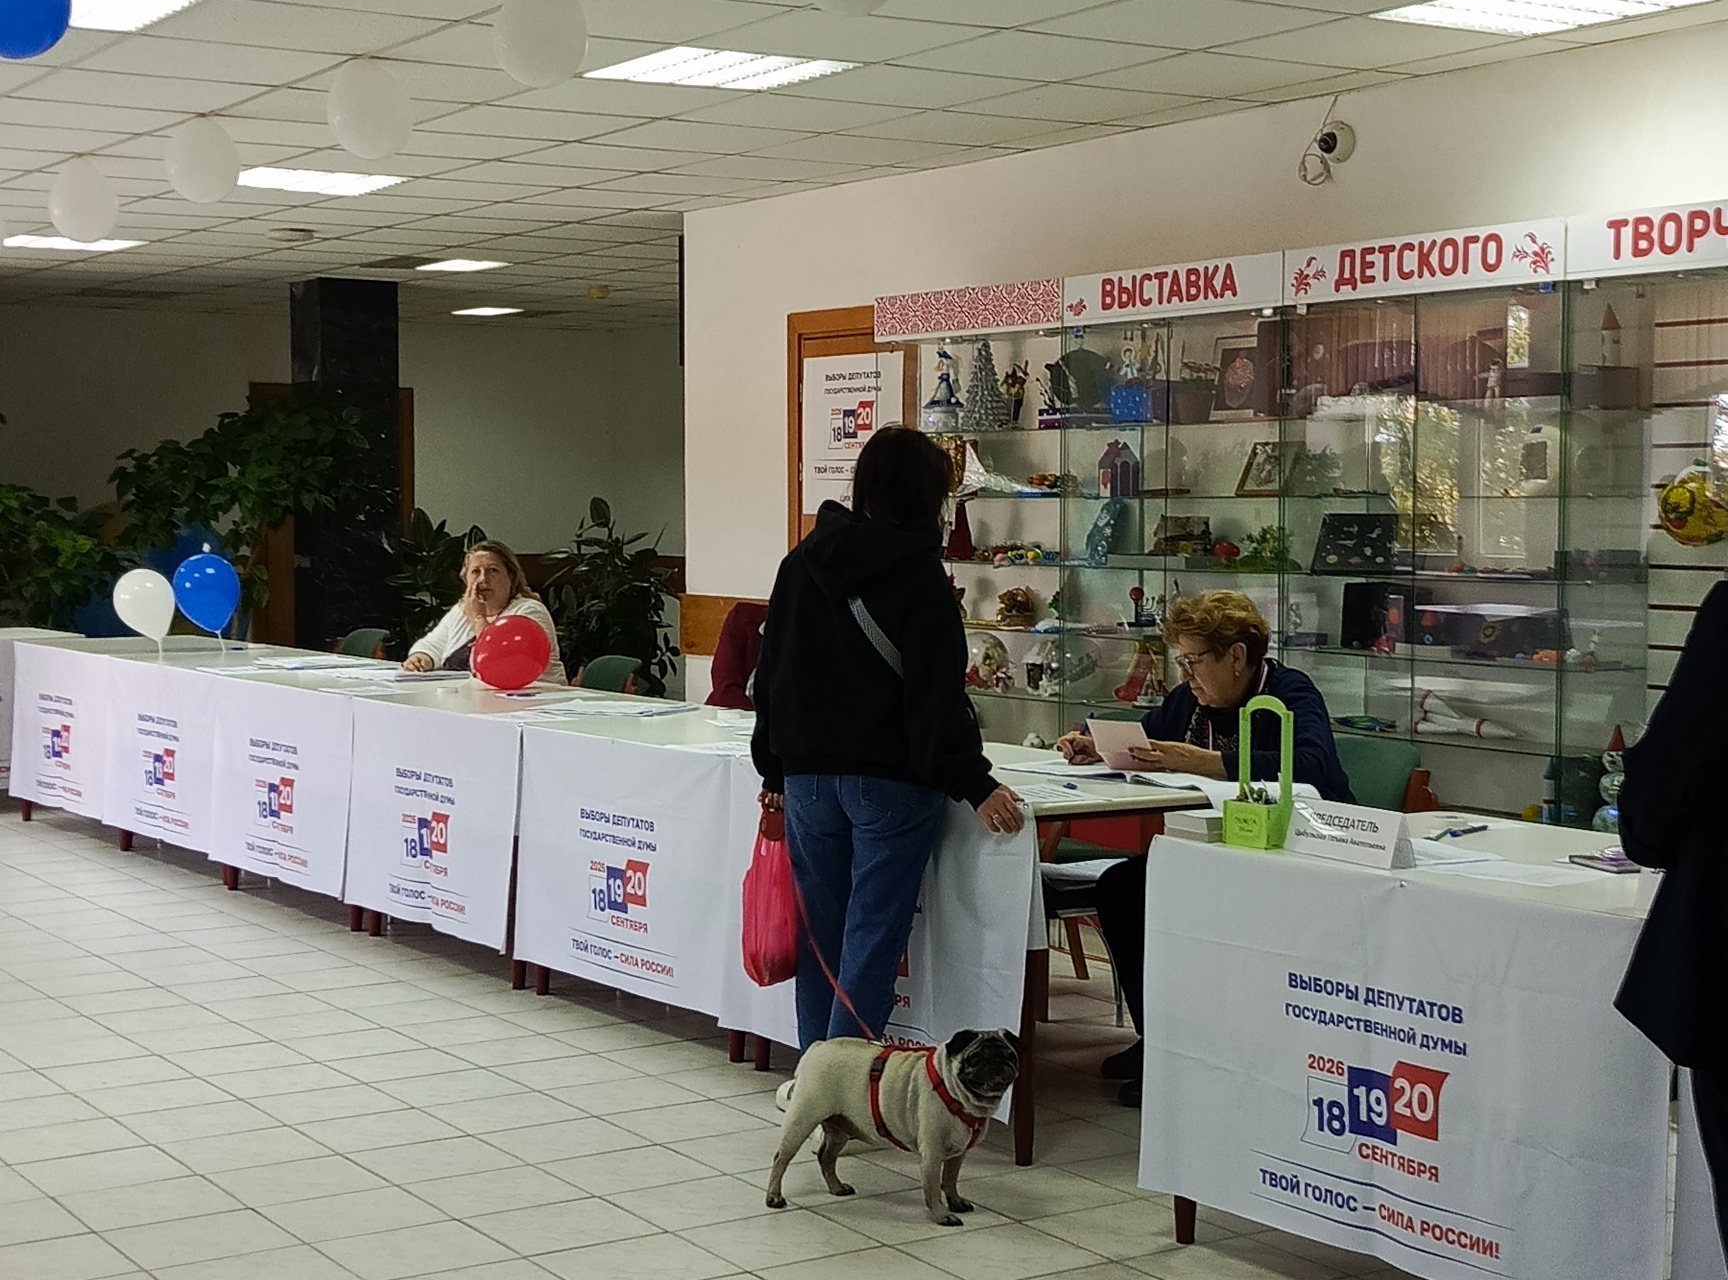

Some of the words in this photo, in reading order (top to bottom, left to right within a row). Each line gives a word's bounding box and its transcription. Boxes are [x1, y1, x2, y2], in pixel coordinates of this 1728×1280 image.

[1100, 262, 1238, 311] ВЫСТАВКА
[1333, 232, 1502, 293] ДЕТСКОГО
[832, 426, 843, 442] 18
[844, 416, 855, 434] 19
[857, 407, 872, 425] 20
[844, 441, 865, 449] СЕНТЯ
[257, 800, 268, 819] 18
[279, 785, 292, 805] 20
[580, 808, 610, 824] ВЫБОРЫ
[612, 814, 655, 832] ДЕПУТАТОВ
[404, 837, 418, 859] 18
[431, 822, 446, 844] 20
[1314, 812, 1379, 833] РЕДСЕДАТЕЛЬ
[637, 840, 657, 852] ДУМЫ
[592, 887, 607, 913] 18
[608, 878, 624, 903] 19
[626, 871, 645, 896] 20
[611, 915, 648, 934] СЕНТЯБРЯ
[572, 938, 589, 953] ТВОЙ
[590, 944, 612, 960] ГОЛОС
[620, 953, 639, 969] СИЛА
[640, 959, 674, 978] РОССИИ!
[1288, 972, 1359, 1002] ВЫБОРЫ
[1364, 987, 1464, 1024] ДЕПУТАТОВ
[1285, 1003, 1416, 1045] ГОСУДАРСТВЕННОЙ
[1419, 1035, 1467, 1057] ДУМЫ
[1307, 1053, 1345, 1076] 2026
[1312, 1097, 1346, 1136] 18
[1353, 1086, 1388, 1126] 19
[1393, 1078, 1434, 1121] 20
[1358, 1142, 1439, 1183] СЕНТЯБРЯ
[1259, 1168, 1300, 1195] ТВОЙ
[1304, 1183, 1358, 1212] ГОЛОС
[1378, 1203, 1415, 1233] СИЛА
[1420, 1222, 1501, 1259] РОССИИ!
